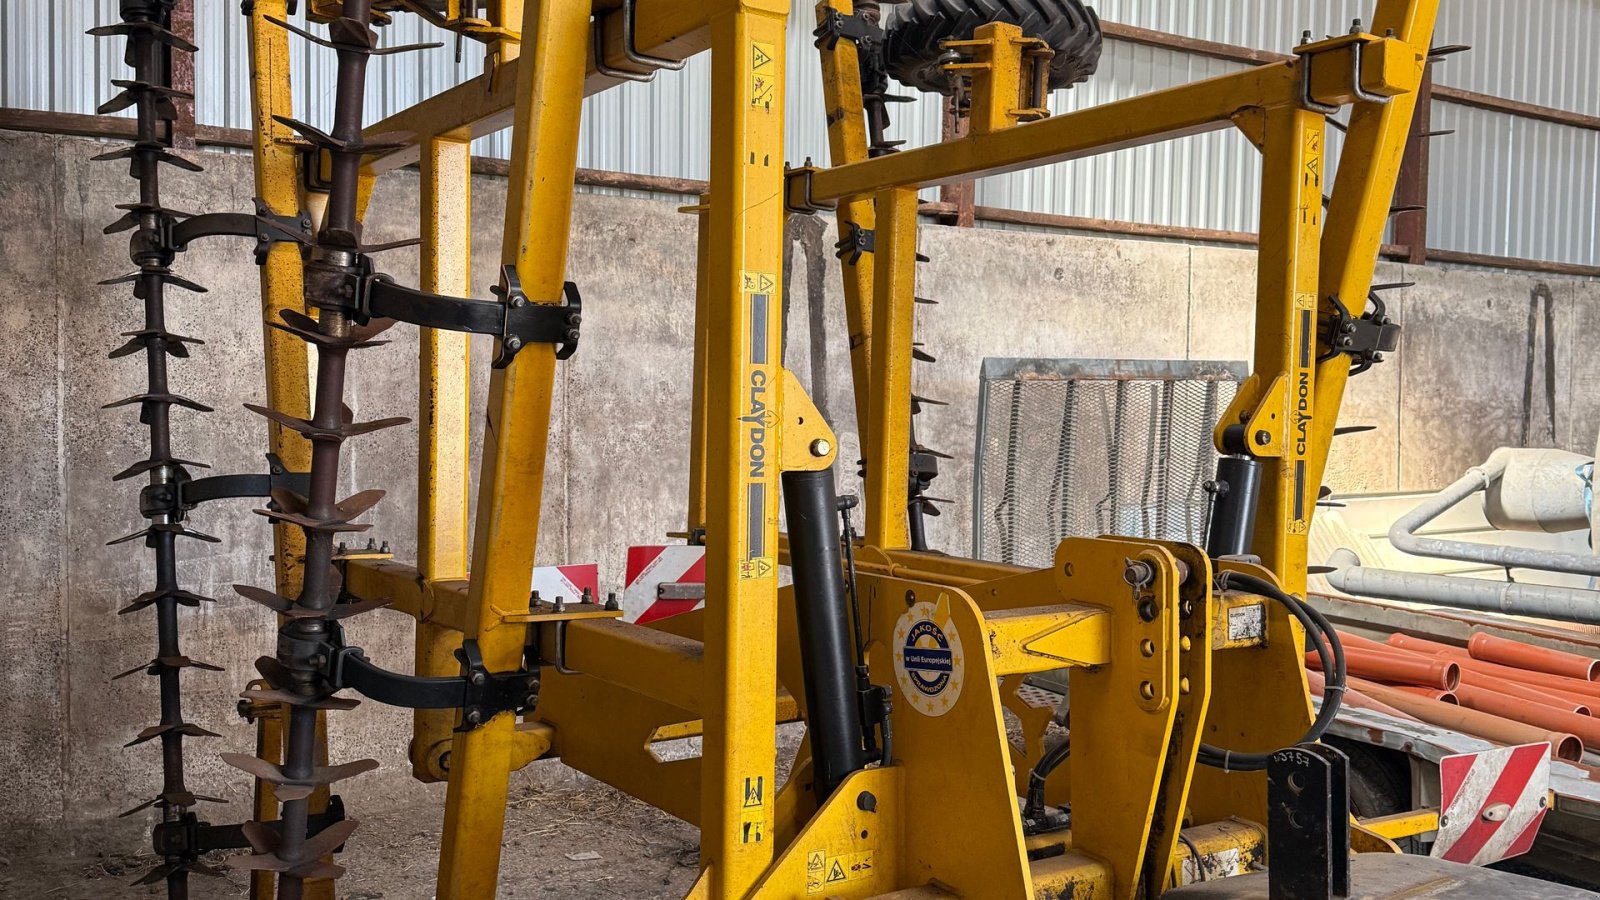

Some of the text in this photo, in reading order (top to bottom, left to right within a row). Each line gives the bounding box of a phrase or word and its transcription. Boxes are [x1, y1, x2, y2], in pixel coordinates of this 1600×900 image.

[741, 370, 766, 477] CLAYDON
[1296, 372, 1312, 455] CLAYDON
[921, 656, 951, 666] Europejskiej
